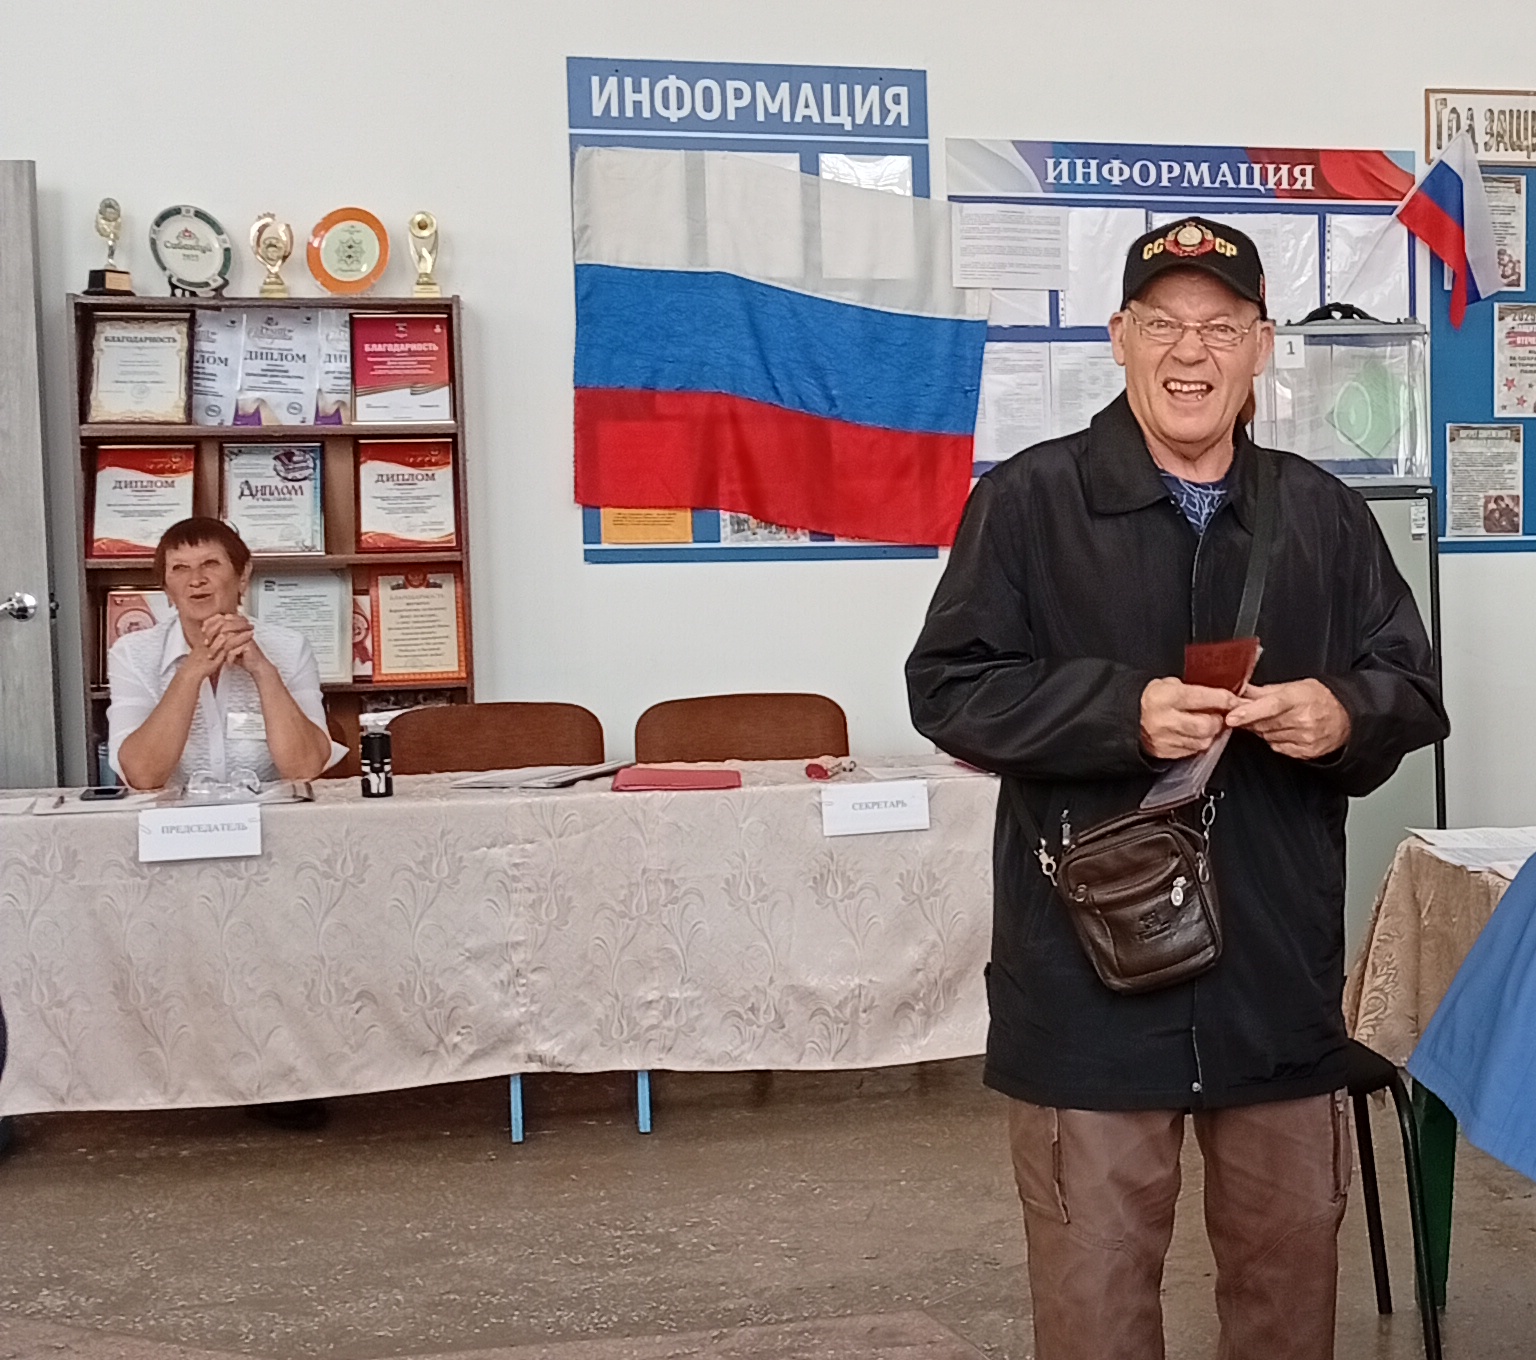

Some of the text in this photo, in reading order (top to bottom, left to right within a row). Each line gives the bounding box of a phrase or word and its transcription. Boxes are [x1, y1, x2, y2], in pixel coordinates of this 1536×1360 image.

[591, 74, 911, 131] ИНФОРМАЦИЯ
[1044, 157, 1315, 193] ИНФОРМАЦИЯ
[104, 335, 178, 344] БЛАГОДАРНОСТЬ
[364, 342, 439, 353] БЛАГОДАРНОСТЬ
[1286, 341, 1296, 355] 1
[195, 353, 229, 367] ЛОМ
[244, 350, 307, 364] ДИПЛОМ
[112, 480, 176, 490] ДИПЛОМ
[374, 473, 436, 484] ДИПЛОМ
[851, 799, 908, 812] СЕКРЕТАРЬ
[161, 822, 248, 835] ПРЕДСЕДАТЕЛЬ
